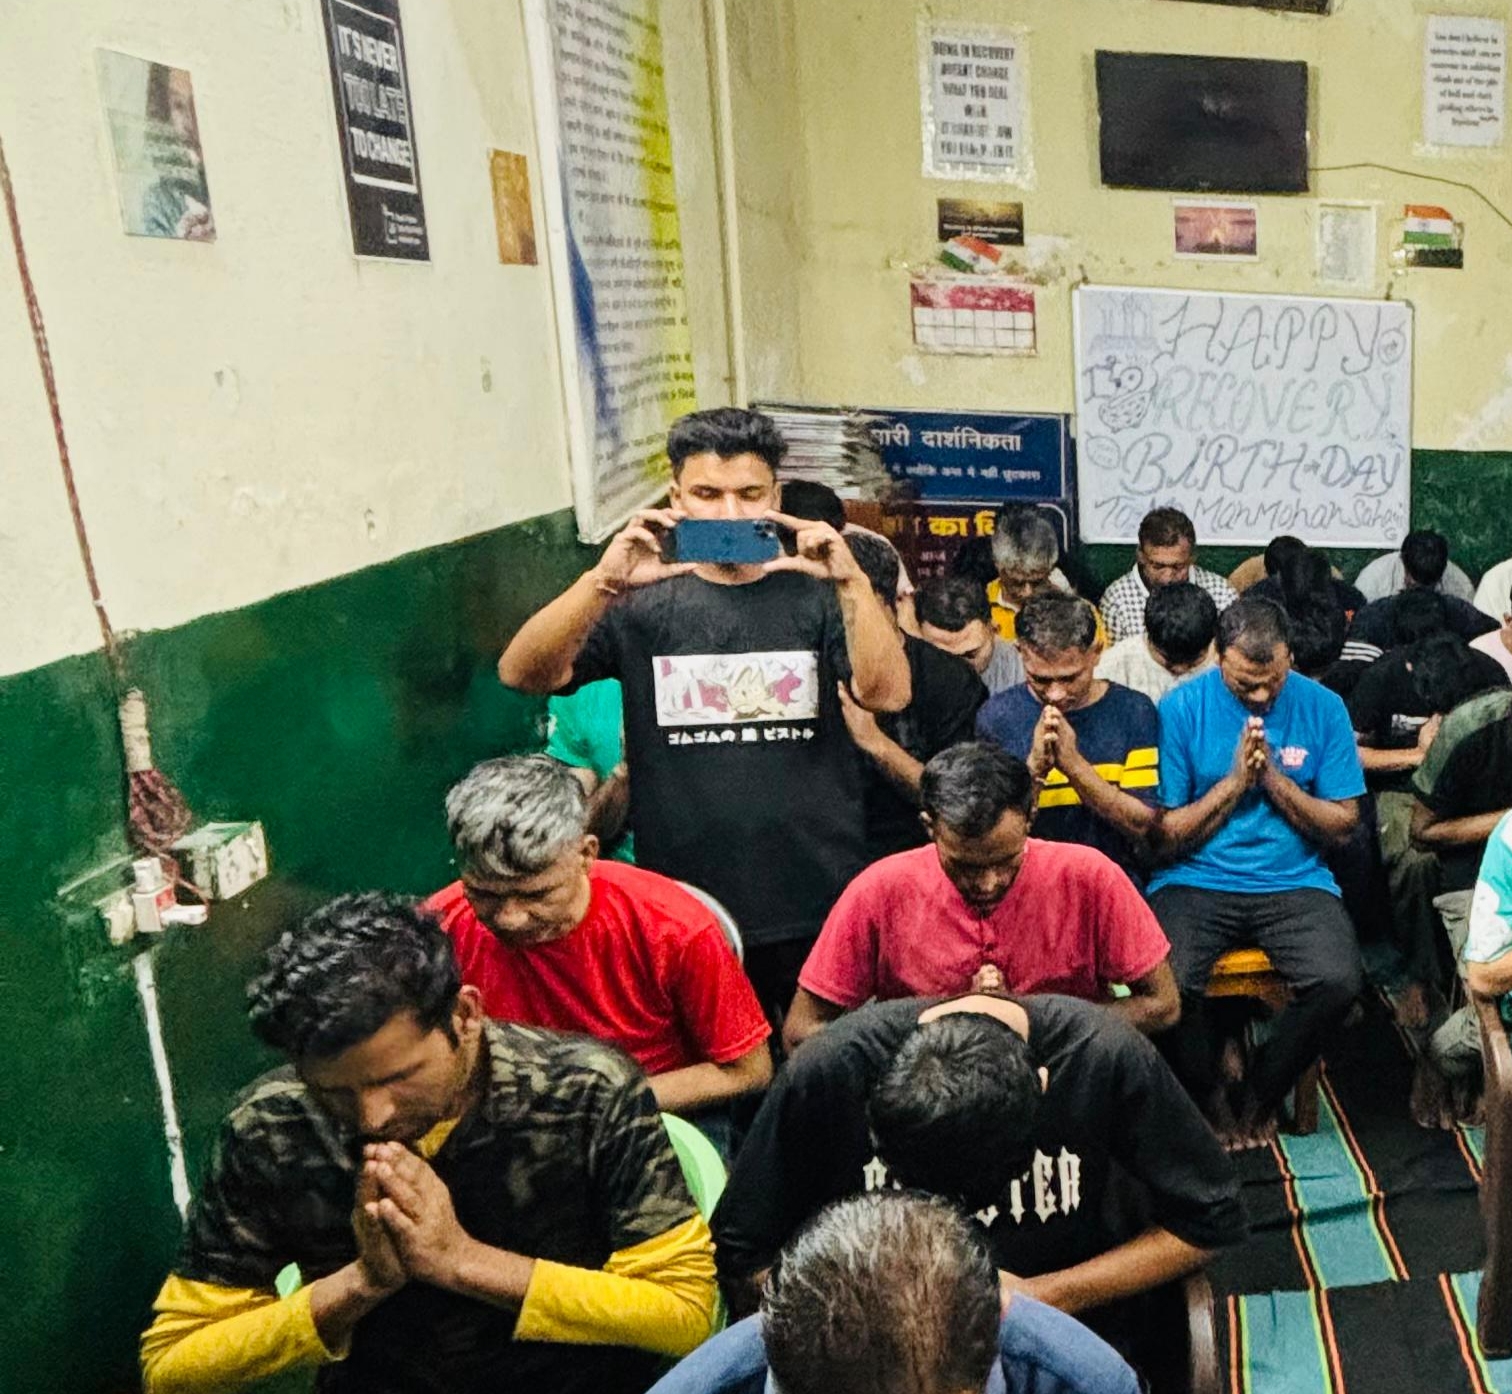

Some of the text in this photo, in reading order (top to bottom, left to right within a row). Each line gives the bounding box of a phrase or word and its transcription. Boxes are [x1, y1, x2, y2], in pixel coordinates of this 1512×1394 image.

[362, 35, 398, 72] NEVER
[367, 133, 411, 165] CHANGE
[1160, 296, 1381, 375] HAPPY
[1152, 363, 1393, 441] RECOVERY
[920, 426, 1021, 451] दार्शनिकता
